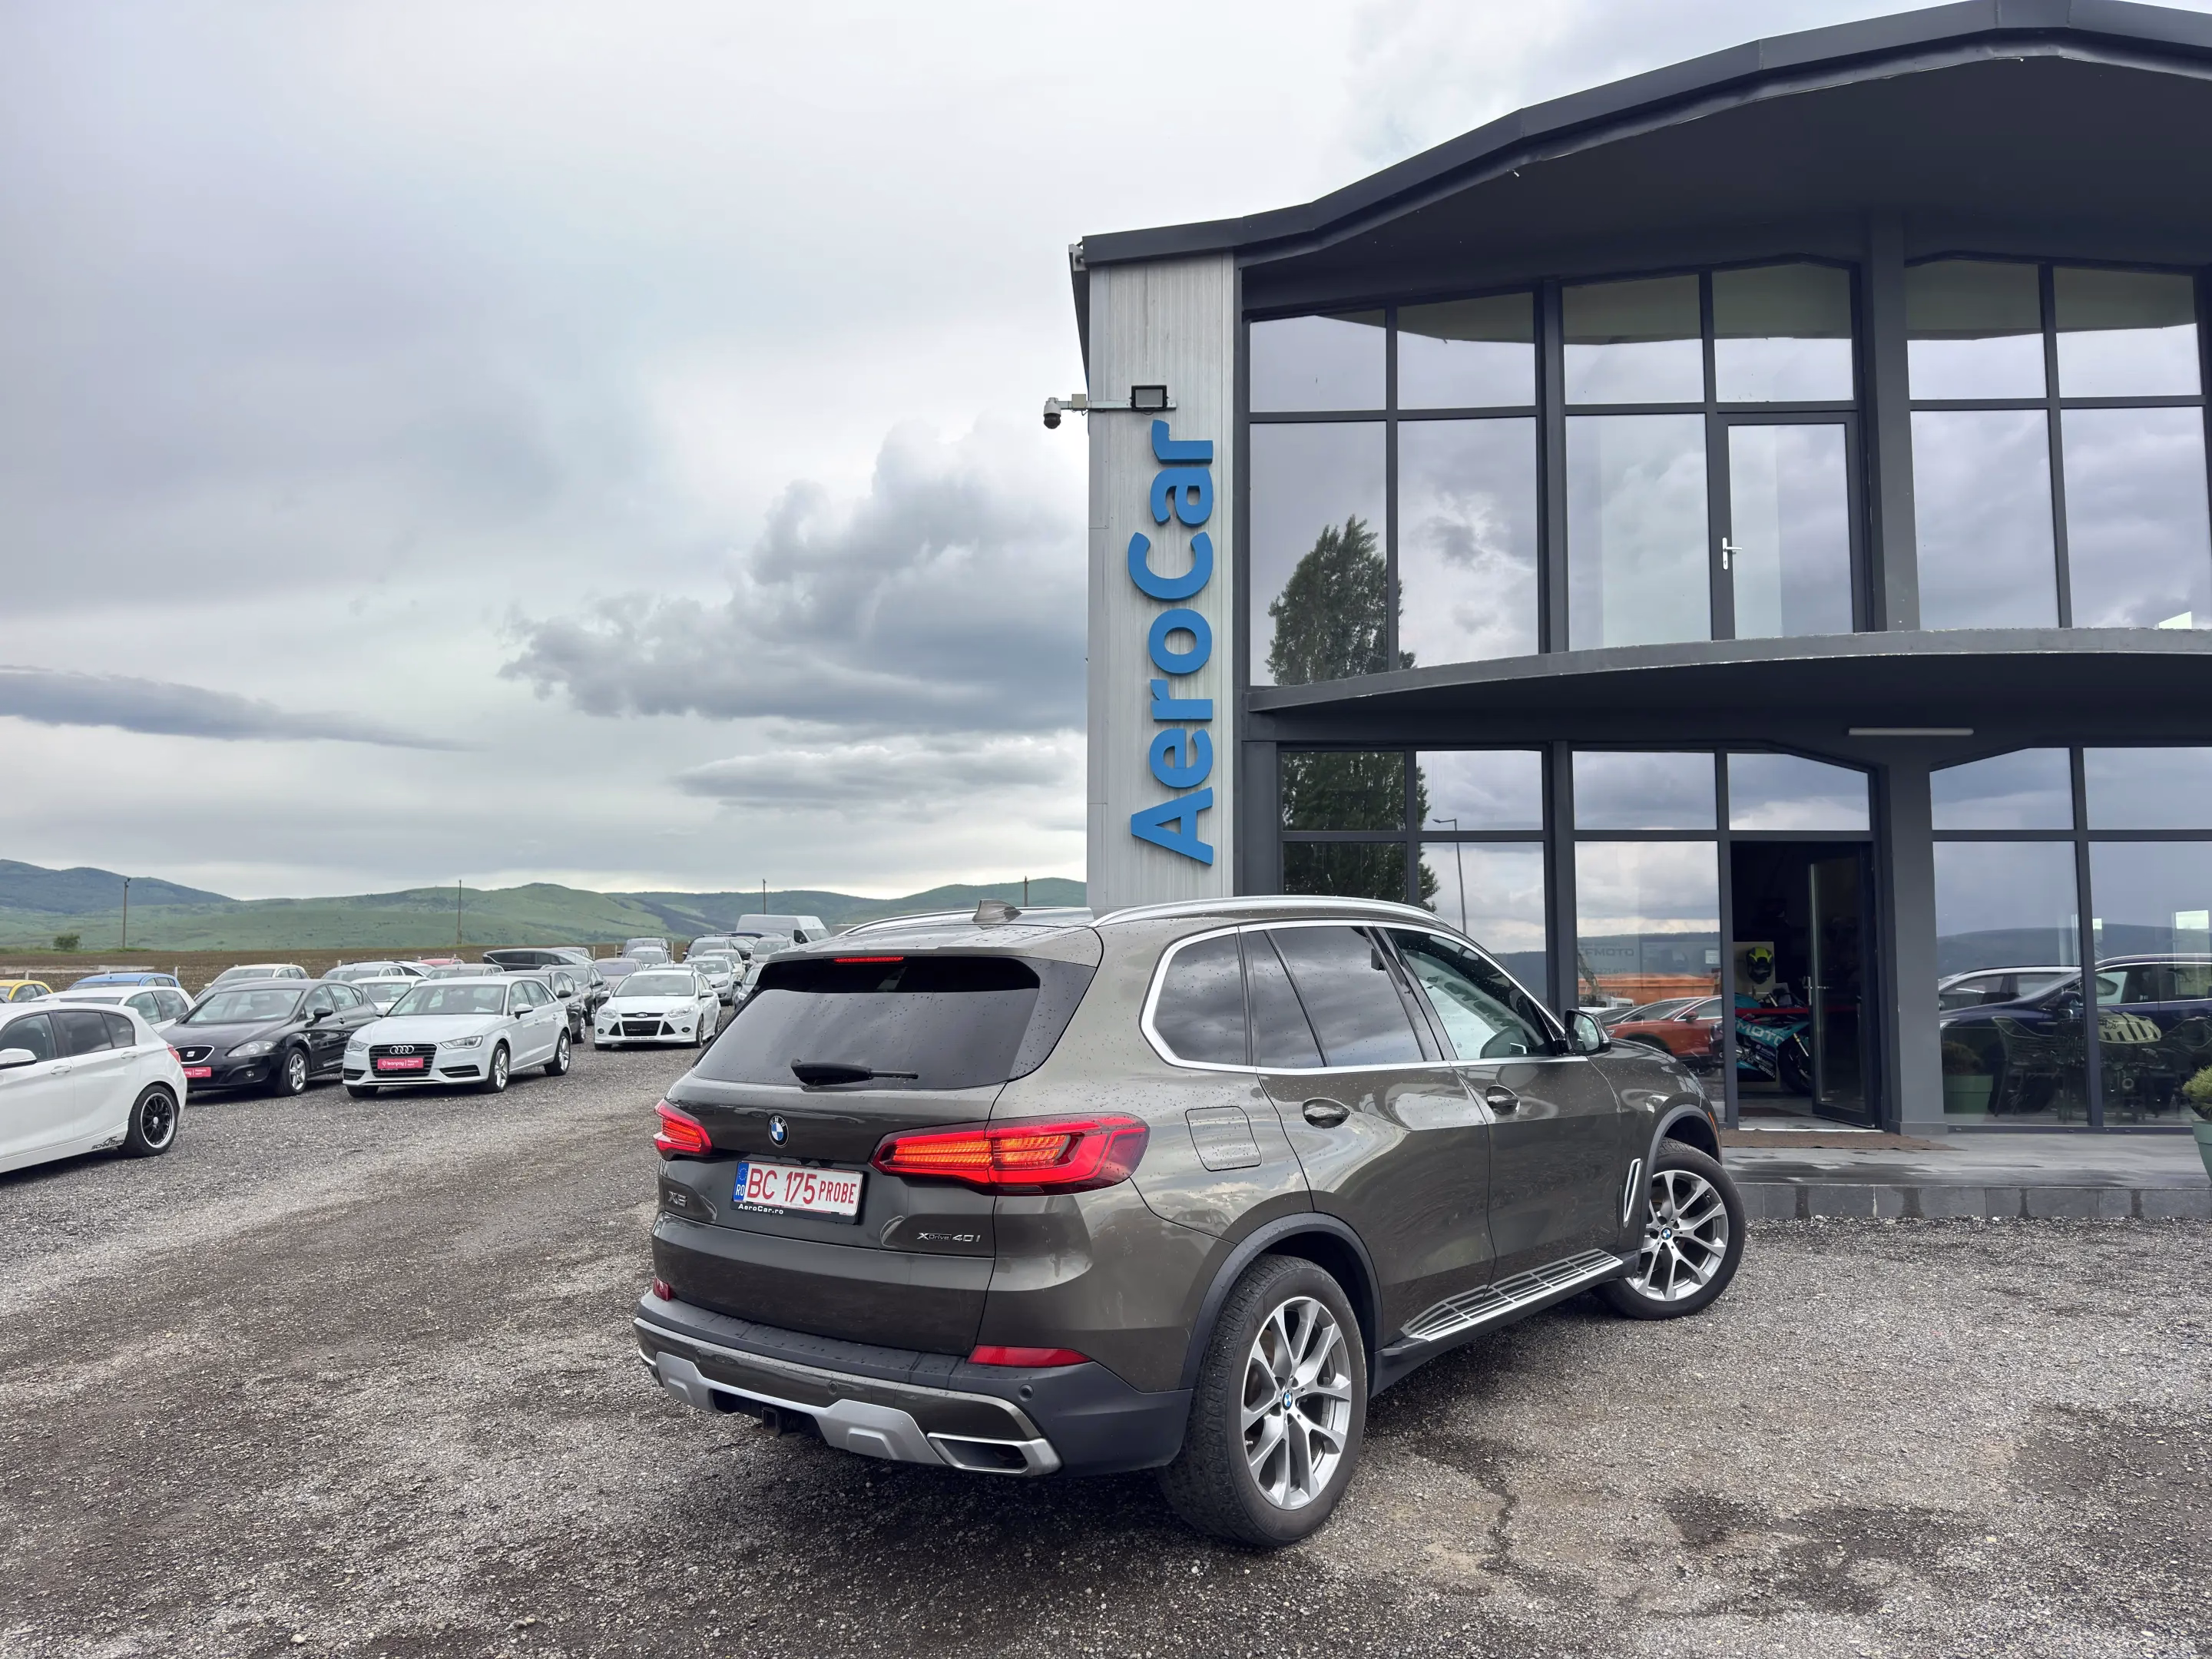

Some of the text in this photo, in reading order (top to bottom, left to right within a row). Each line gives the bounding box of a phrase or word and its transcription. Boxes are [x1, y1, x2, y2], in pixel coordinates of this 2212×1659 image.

[1128, 419, 1214, 866] AeroCar
[736, 1184, 745, 1197] RO
[747, 1168, 857, 1204] BC 175 PROBE
[738, 1204, 784, 1215] AeroCar.ro
